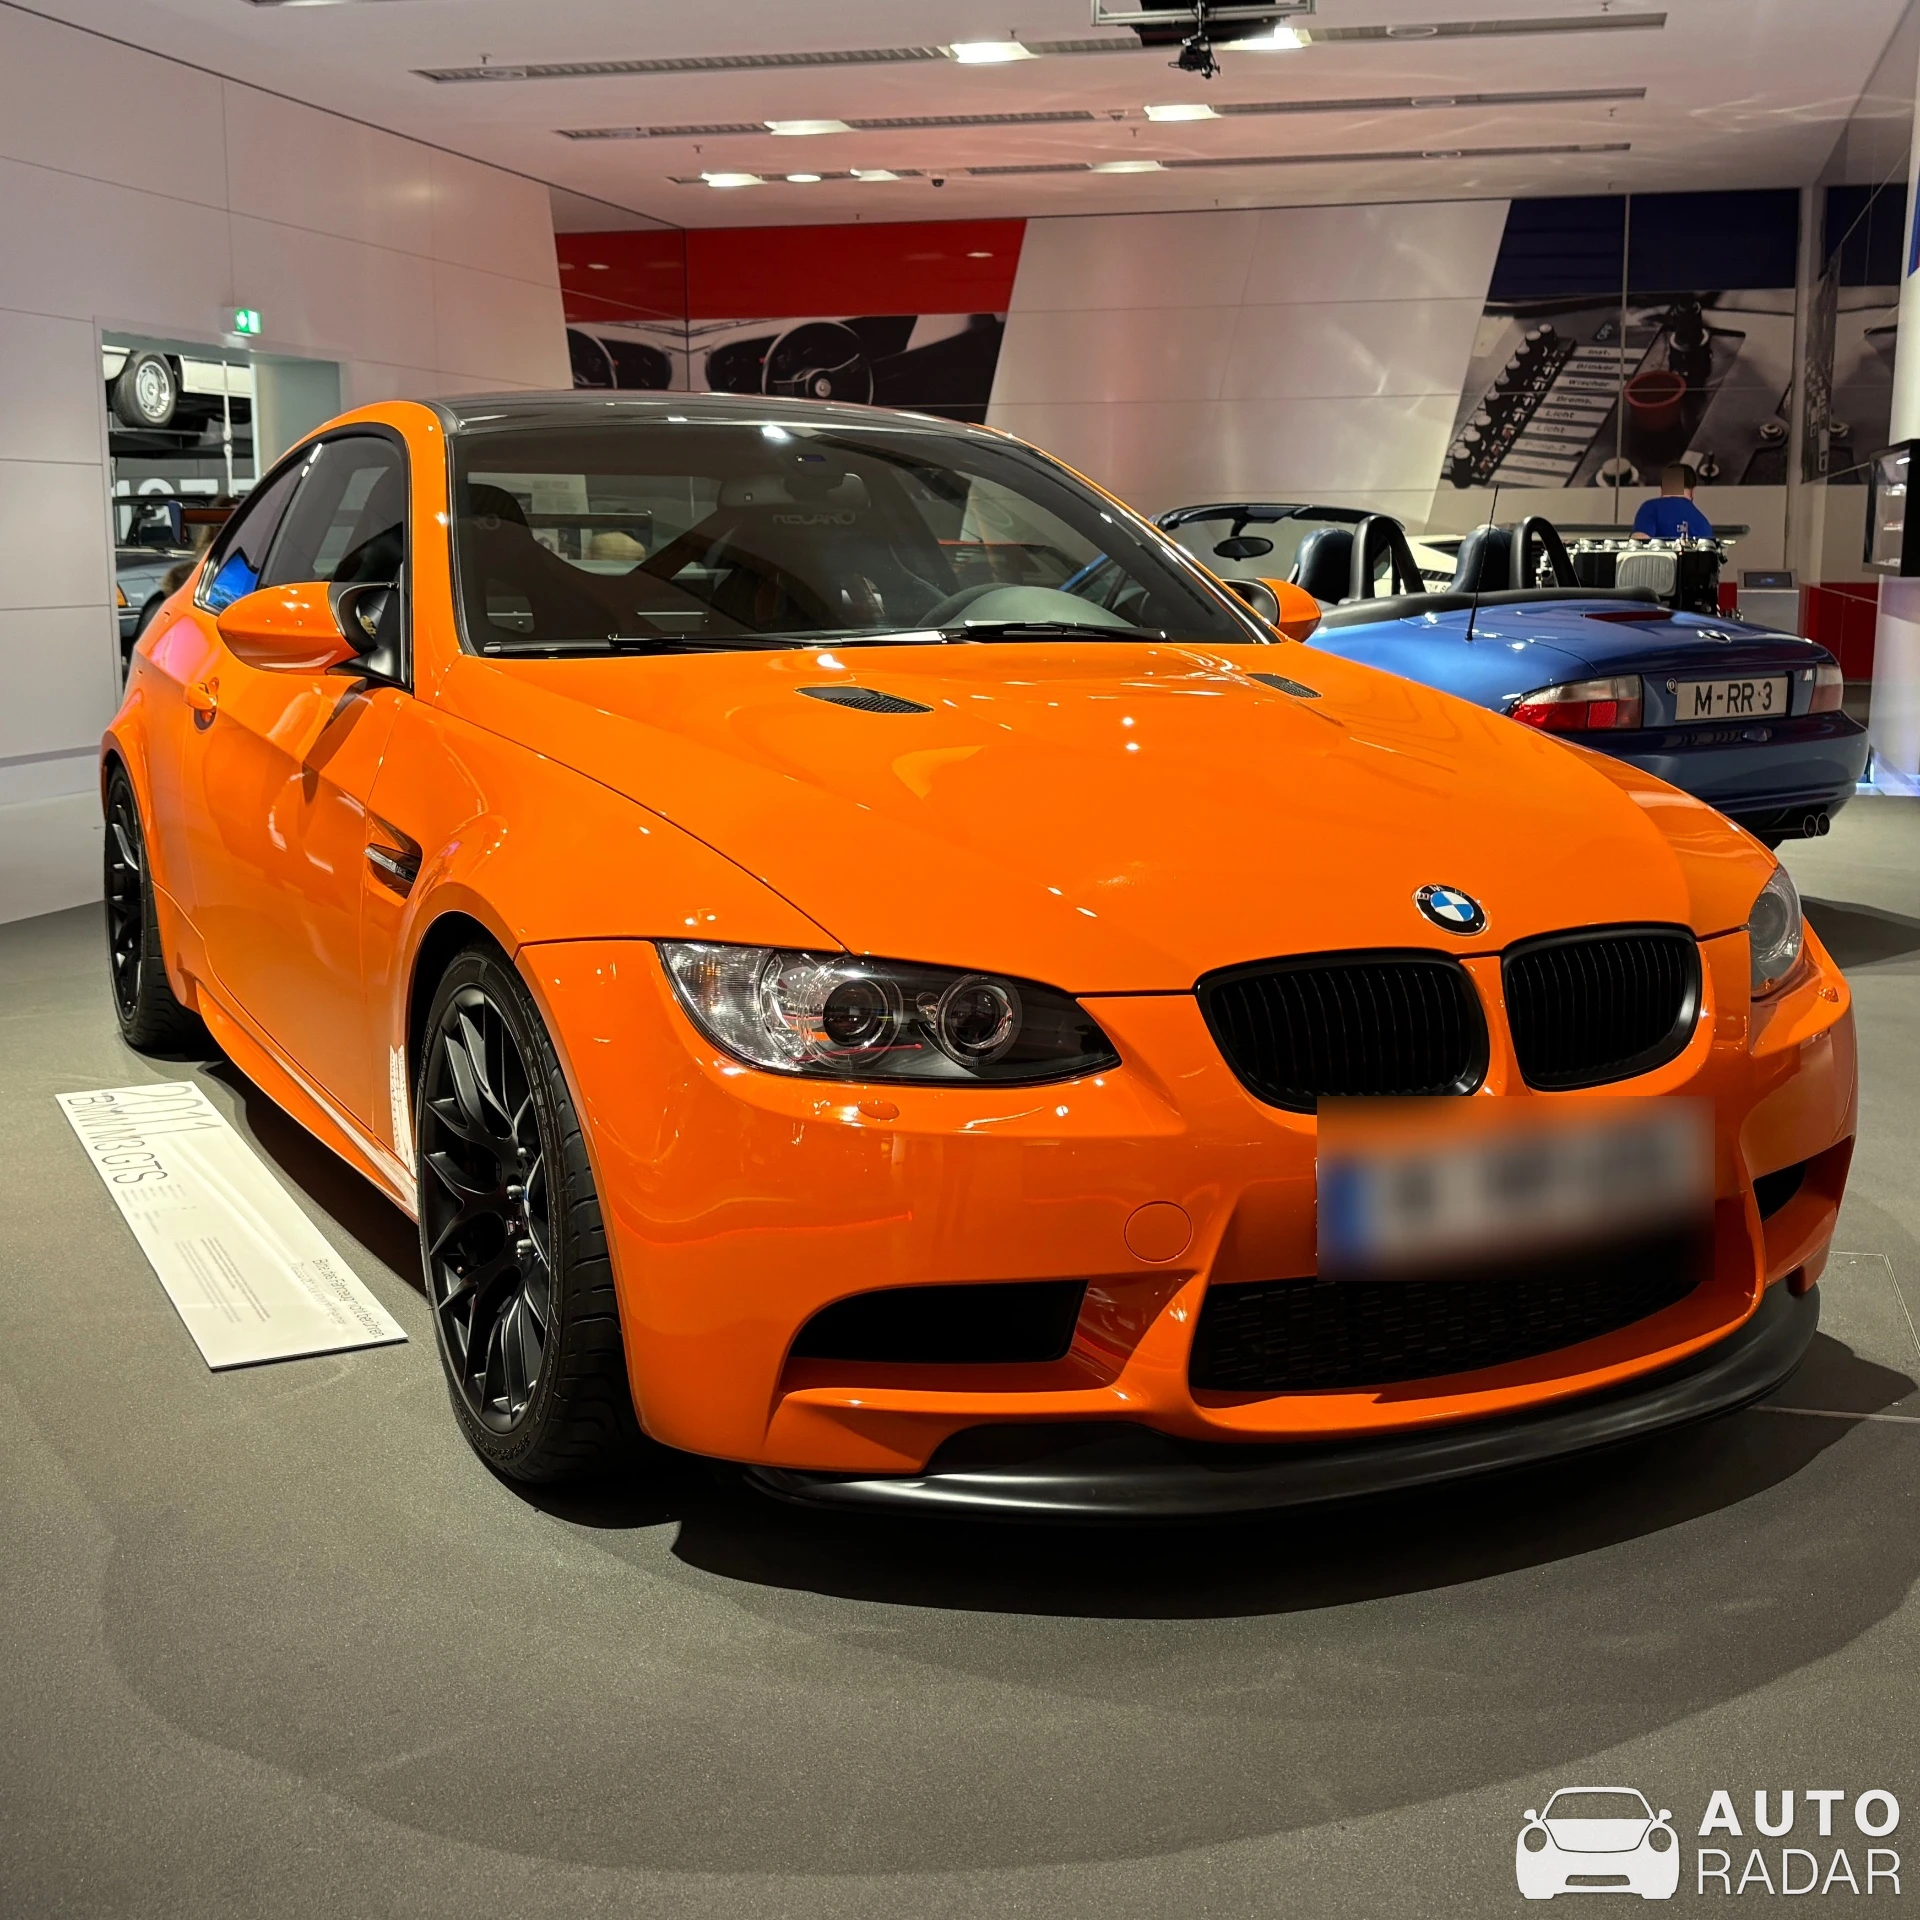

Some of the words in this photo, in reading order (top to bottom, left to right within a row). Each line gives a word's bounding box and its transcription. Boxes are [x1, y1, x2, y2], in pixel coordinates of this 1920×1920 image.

[101, 1085, 221, 1137] 2011
[86, 1128, 146, 1151] M3
[101, 1152, 169, 1184] GTS
